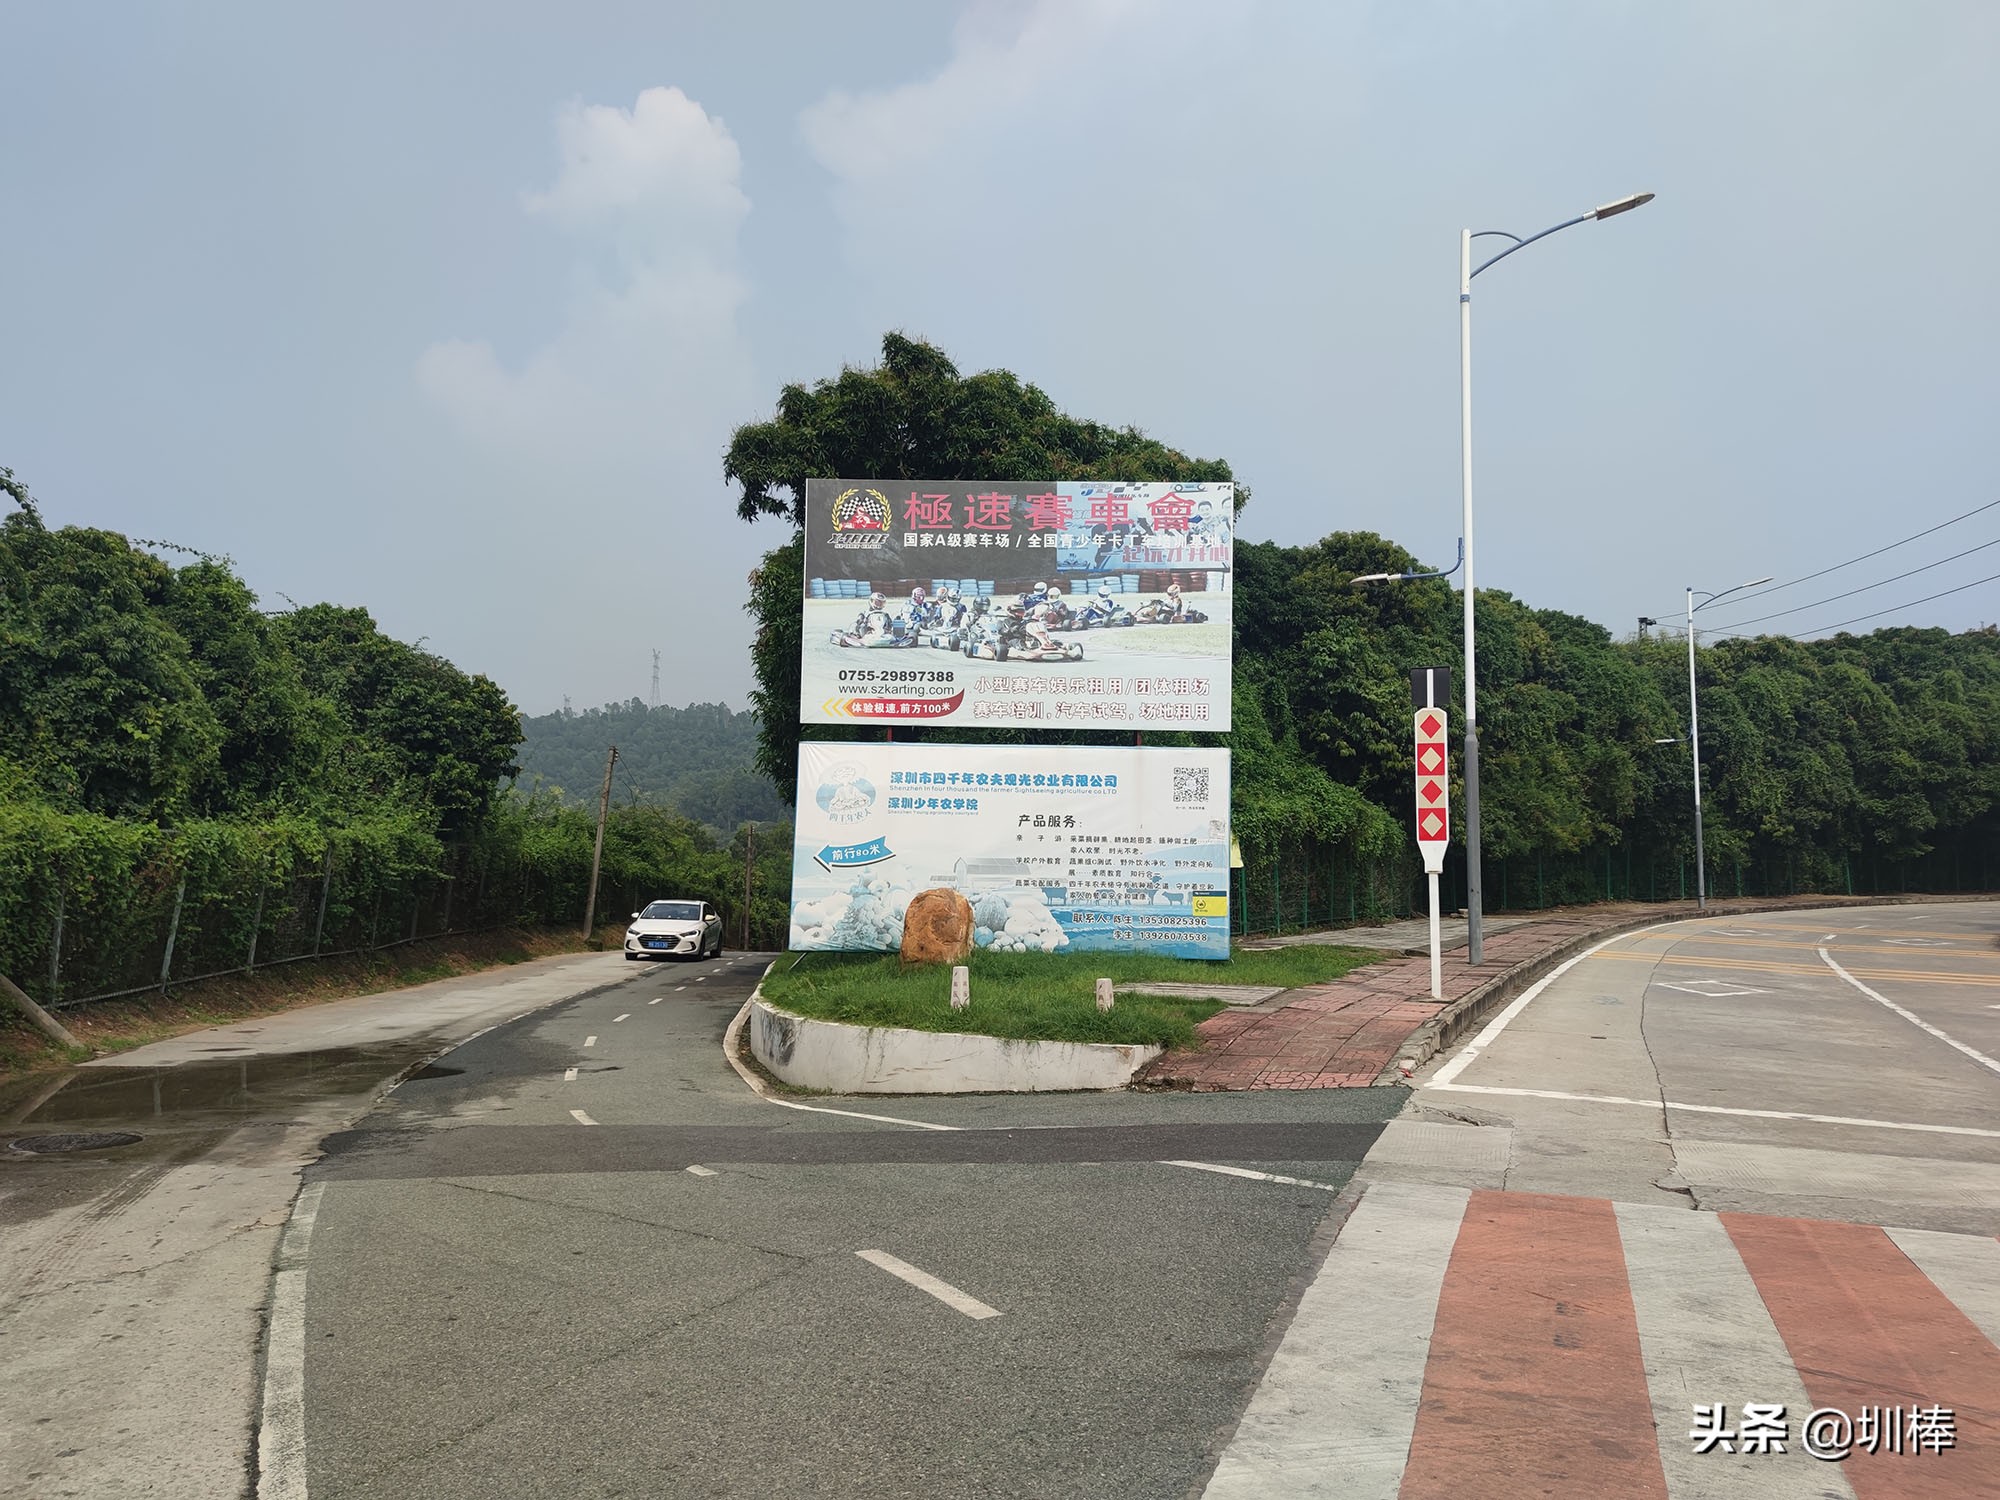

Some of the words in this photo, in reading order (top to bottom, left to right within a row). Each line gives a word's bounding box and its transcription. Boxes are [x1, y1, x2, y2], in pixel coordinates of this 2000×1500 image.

[903, 491, 1196, 531] 極速賽車會
[827, 533, 889, 544] X-TREME
[903, 532, 1010, 548] 国家A级赛车场
[838, 670, 955, 682] 0755-29897388
[838, 683, 955, 697] www.szkarting.com
[973, 677, 1210, 696] 小型赛车娱乐租用/团体租场
[890, 771, 1118, 788] 深圳市四千年农夫观光农业有限公司
[888, 797, 978, 810] 深圳少年农学院
[831, 844, 881, 861] 前行80米
[1139, 916, 1208, 926] 13530825396
[1139, 931, 1208, 942] 13926073538
